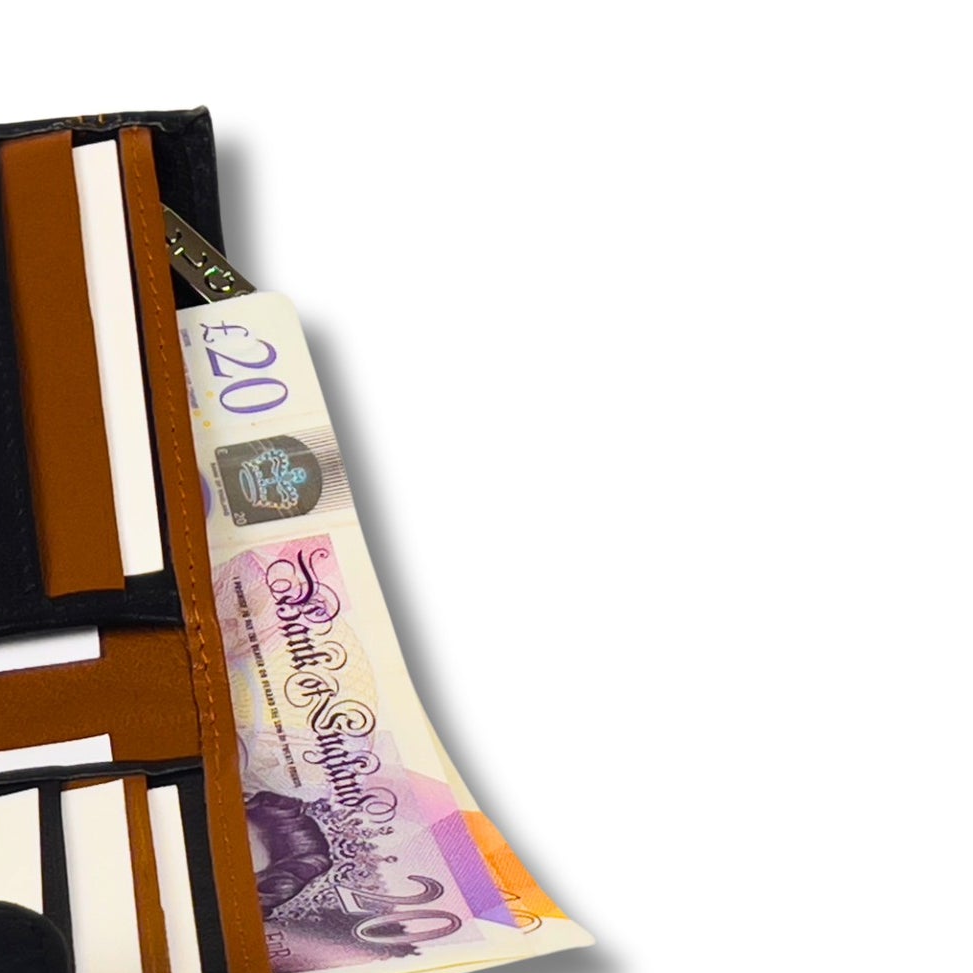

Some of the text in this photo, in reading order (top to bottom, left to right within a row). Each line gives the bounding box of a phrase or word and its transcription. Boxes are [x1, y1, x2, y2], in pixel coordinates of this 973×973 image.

[200, 320, 289, 414] £20
[266, 548, 347, 672] Bank
[302, 697, 398, 824] England
[333, 874, 462, 945] 20
